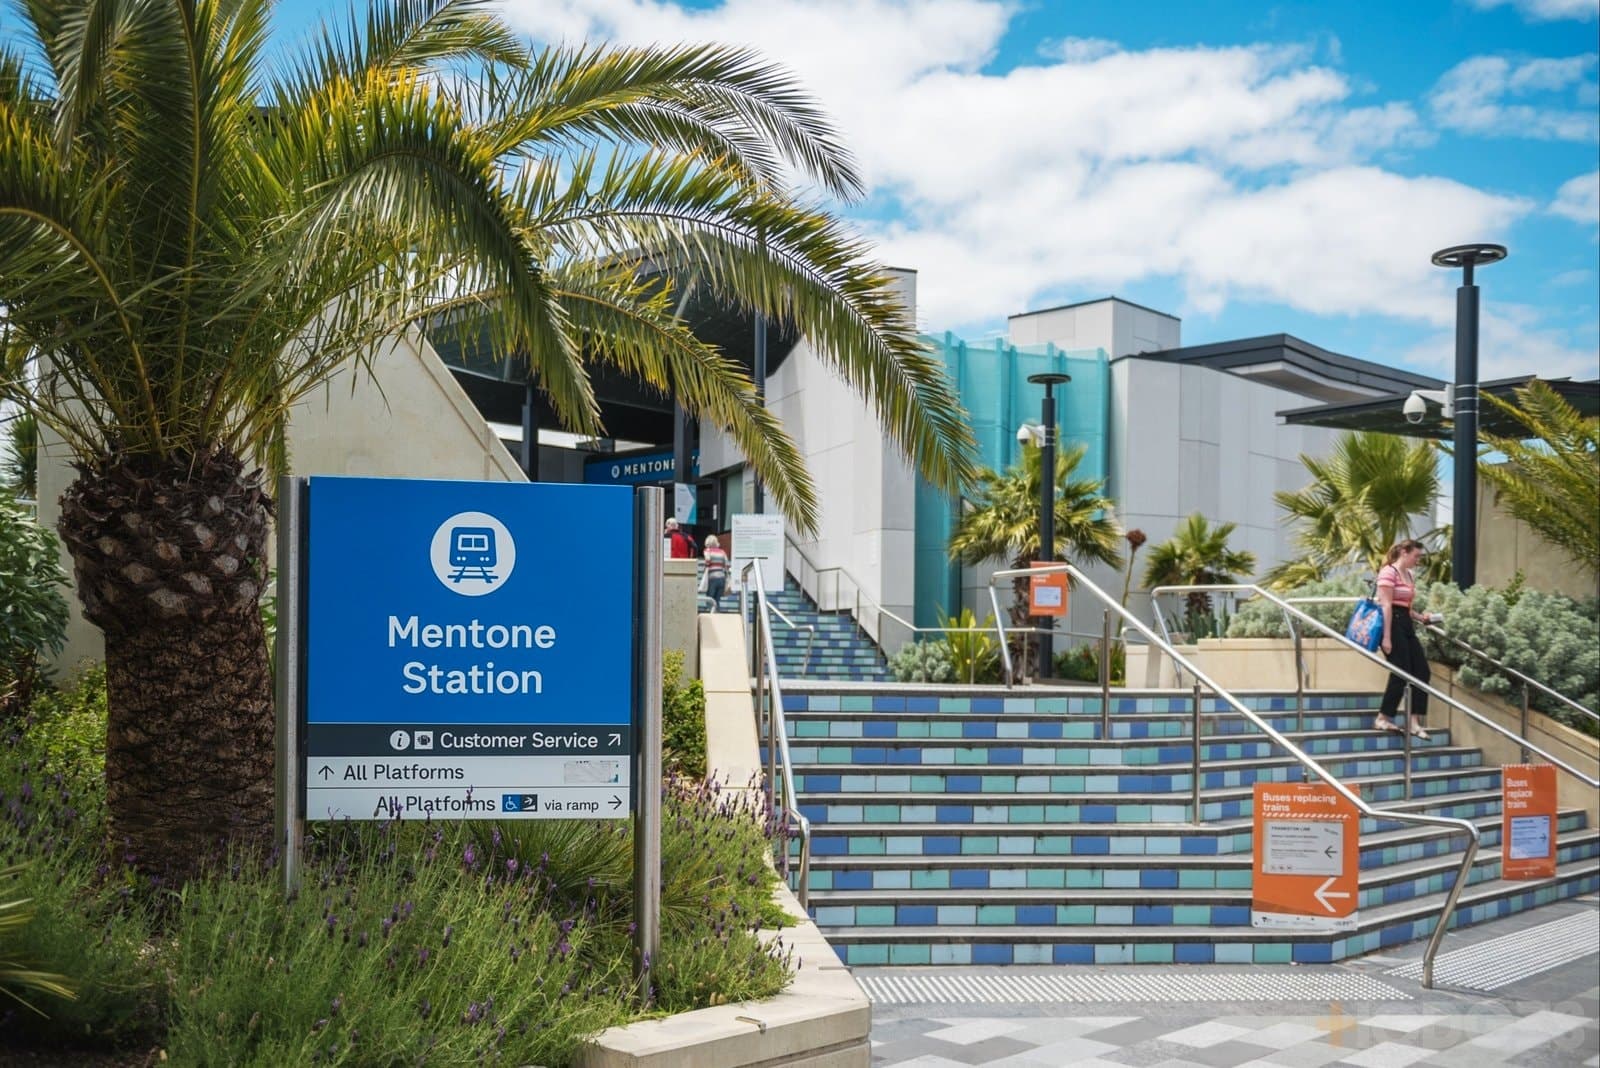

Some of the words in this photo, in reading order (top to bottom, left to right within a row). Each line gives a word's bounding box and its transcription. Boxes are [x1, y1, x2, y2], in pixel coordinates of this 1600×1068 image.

[388, 615, 556, 649] Mentone
[403, 661, 542, 694] Station
[440, 732, 527, 748] Customer
[532, 732, 599, 748] Service
[343, 764, 368, 781] All
[374, 763, 465, 781] Platforms
[376, 796, 398, 812] All
[406, 796, 496, 812] Platforms
[544, 799, 563, 811] via
[566, 801, 599, 813] ramp
[1263, 792, 1291, 802] Buses
[1293, 793, 1337, 805] replacing
[1263, 803, 1290, 812] trains
